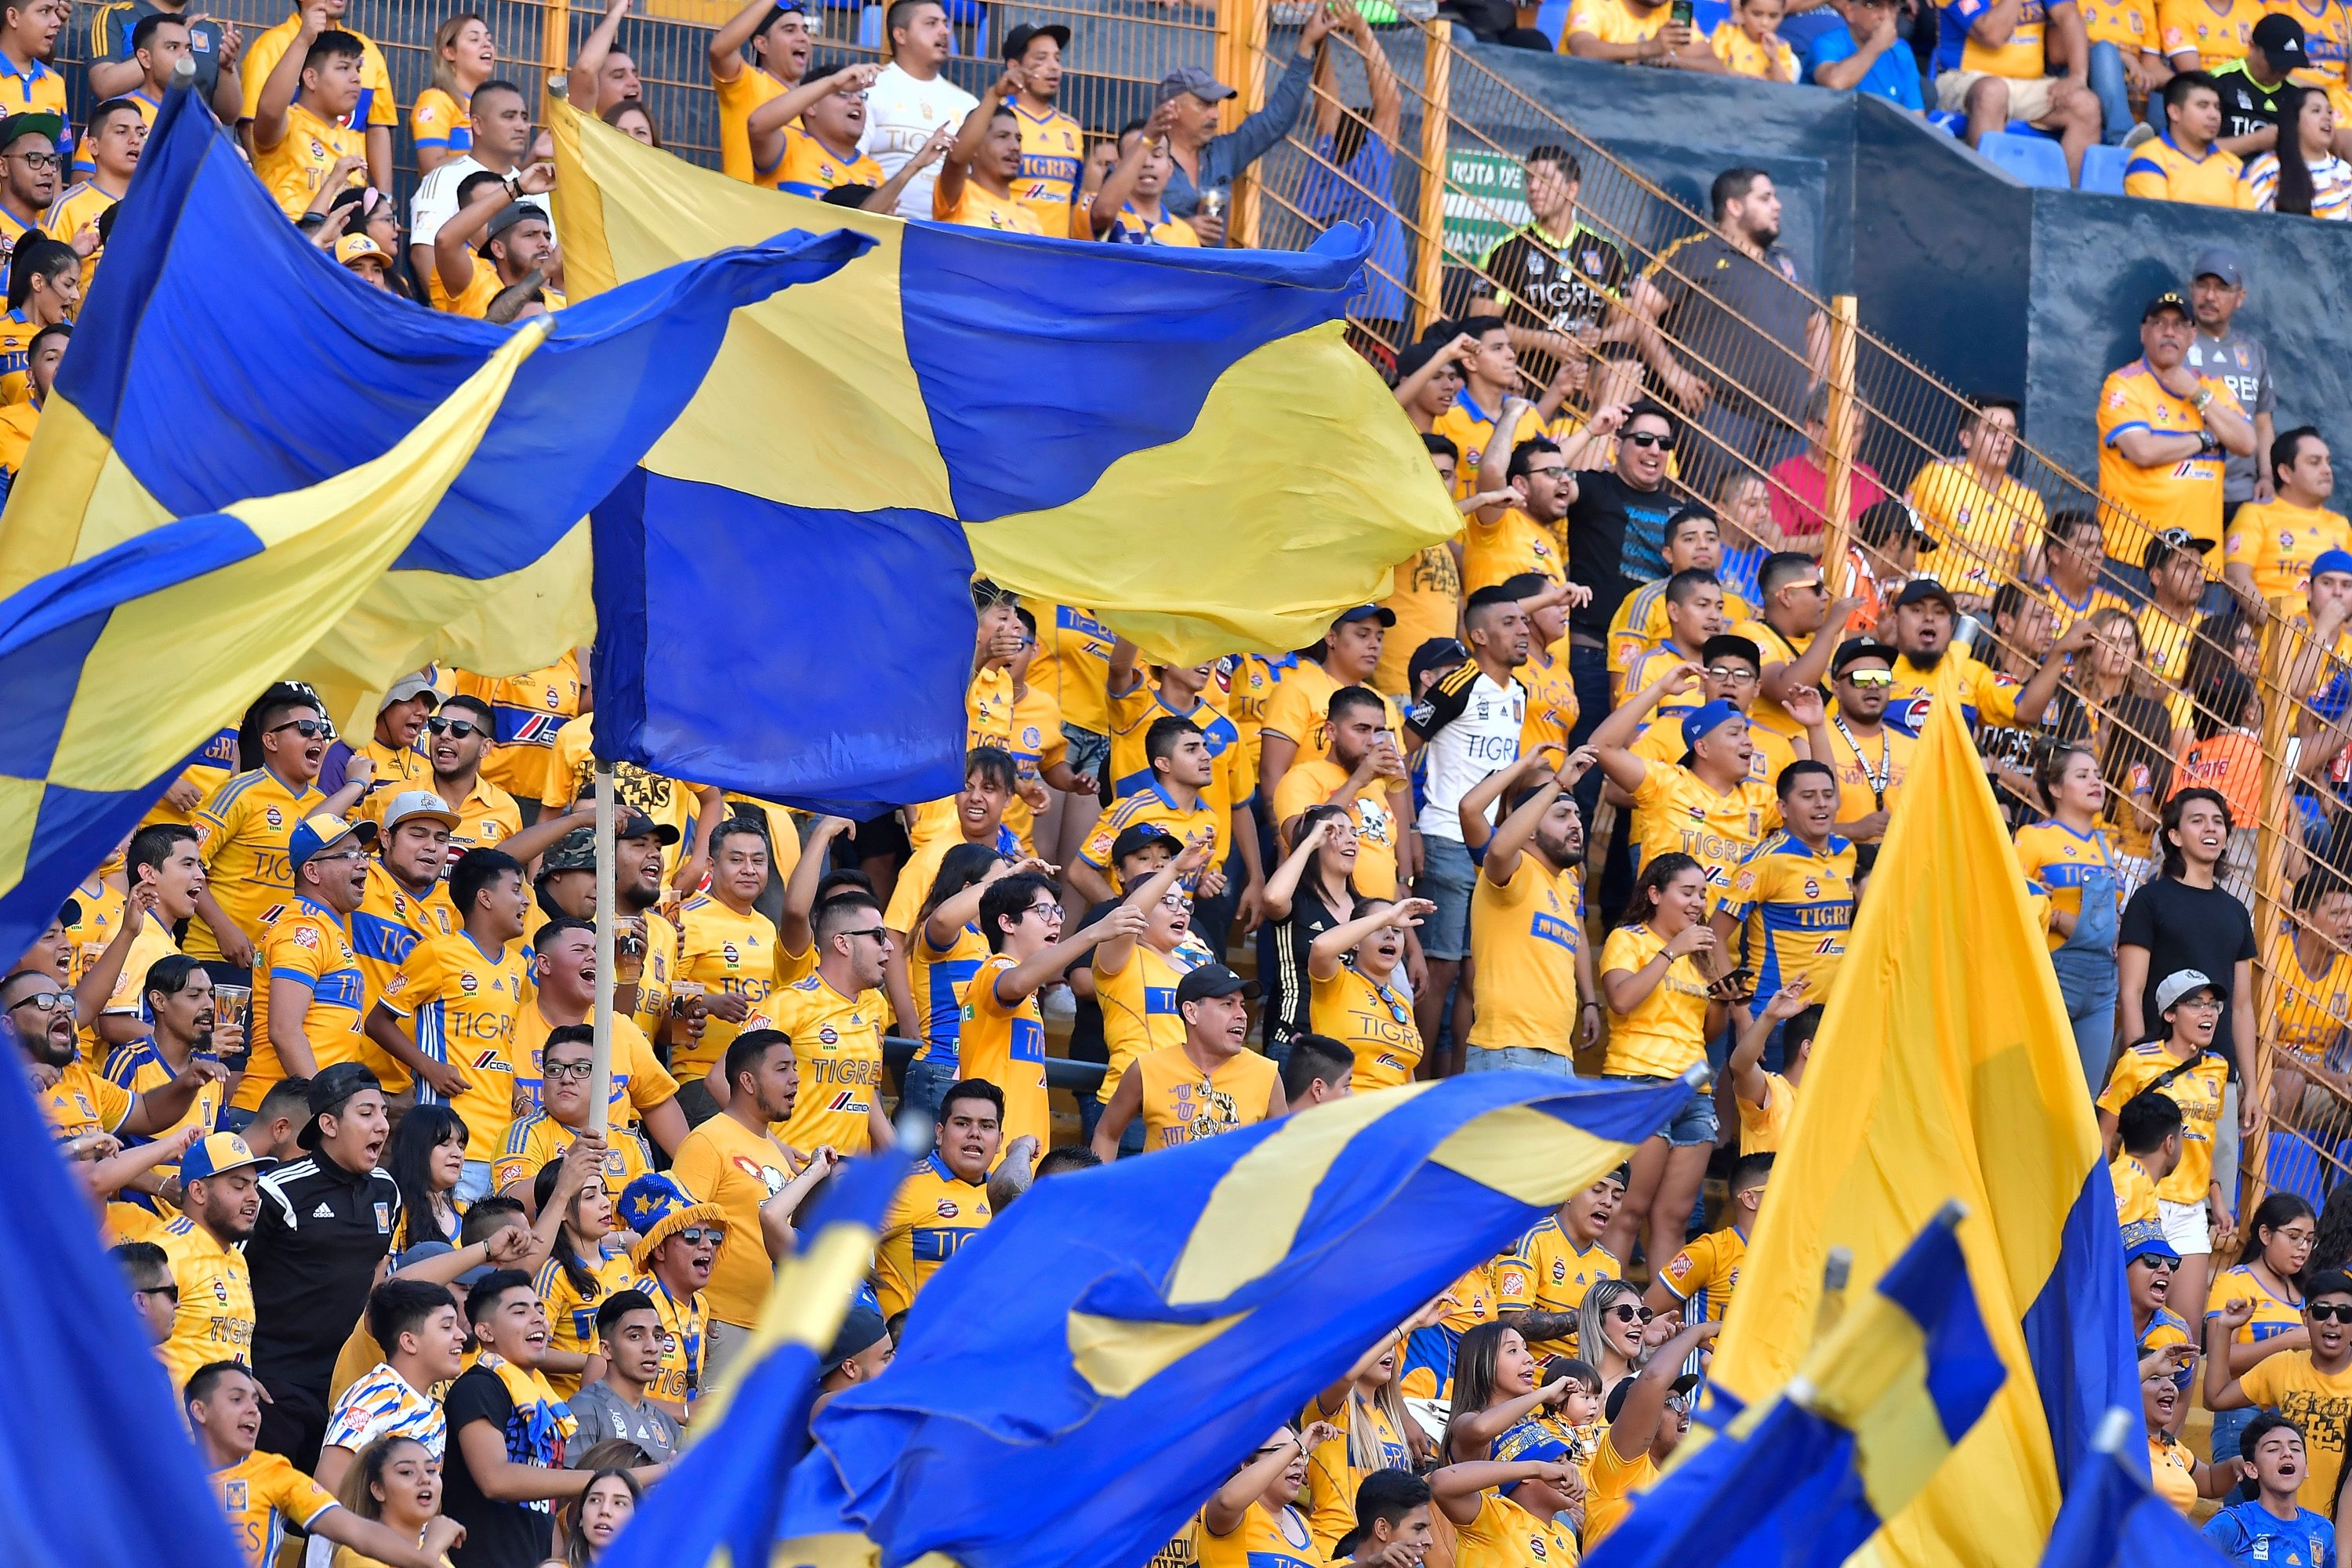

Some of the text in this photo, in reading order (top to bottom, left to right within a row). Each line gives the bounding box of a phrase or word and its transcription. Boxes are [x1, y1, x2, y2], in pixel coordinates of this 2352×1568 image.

[2224, 374, 2259, 401] RES
[1467, 733, 1514, 761] TIGR
[1680, 829, 1754, 863] TIGRE
[253, 851, 293, 881] TIG
[1360, 1016, 1424, 1051] TIGRE
[210, 1316, 255, 1346] TIGRE
[650, 1367, 687, 1396] TIG
